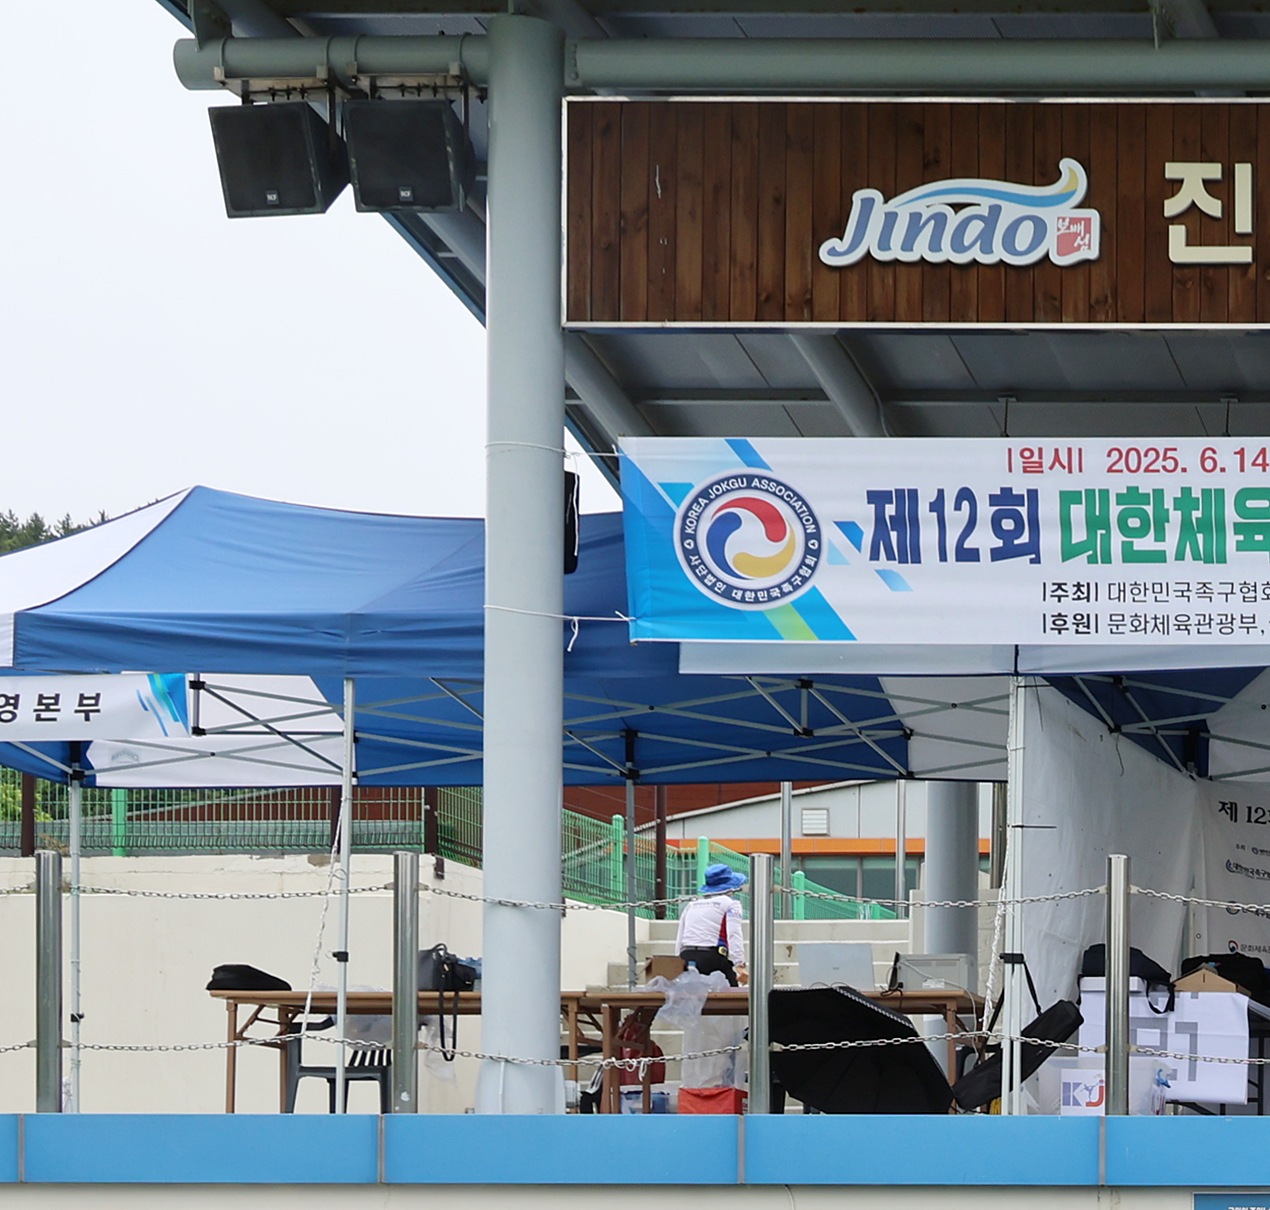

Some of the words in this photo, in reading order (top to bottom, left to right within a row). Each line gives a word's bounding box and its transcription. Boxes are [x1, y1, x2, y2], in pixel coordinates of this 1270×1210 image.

[824, 190, 1049, 262] Jindo
[1105, 447, 1189, 474] 2025.
[684, 497, 710, 534] KOREA
[707, 477, 747, 499] JOKGU
[750, 477, 817, 533] ASSOCIATION
[866, 486, 1042, 565] 제12회
[689, 554, 727, 594] 사단법인
[731, 554, 818, 602] 대한민국족구협회
[1218, 800, 1238, 823] 제
